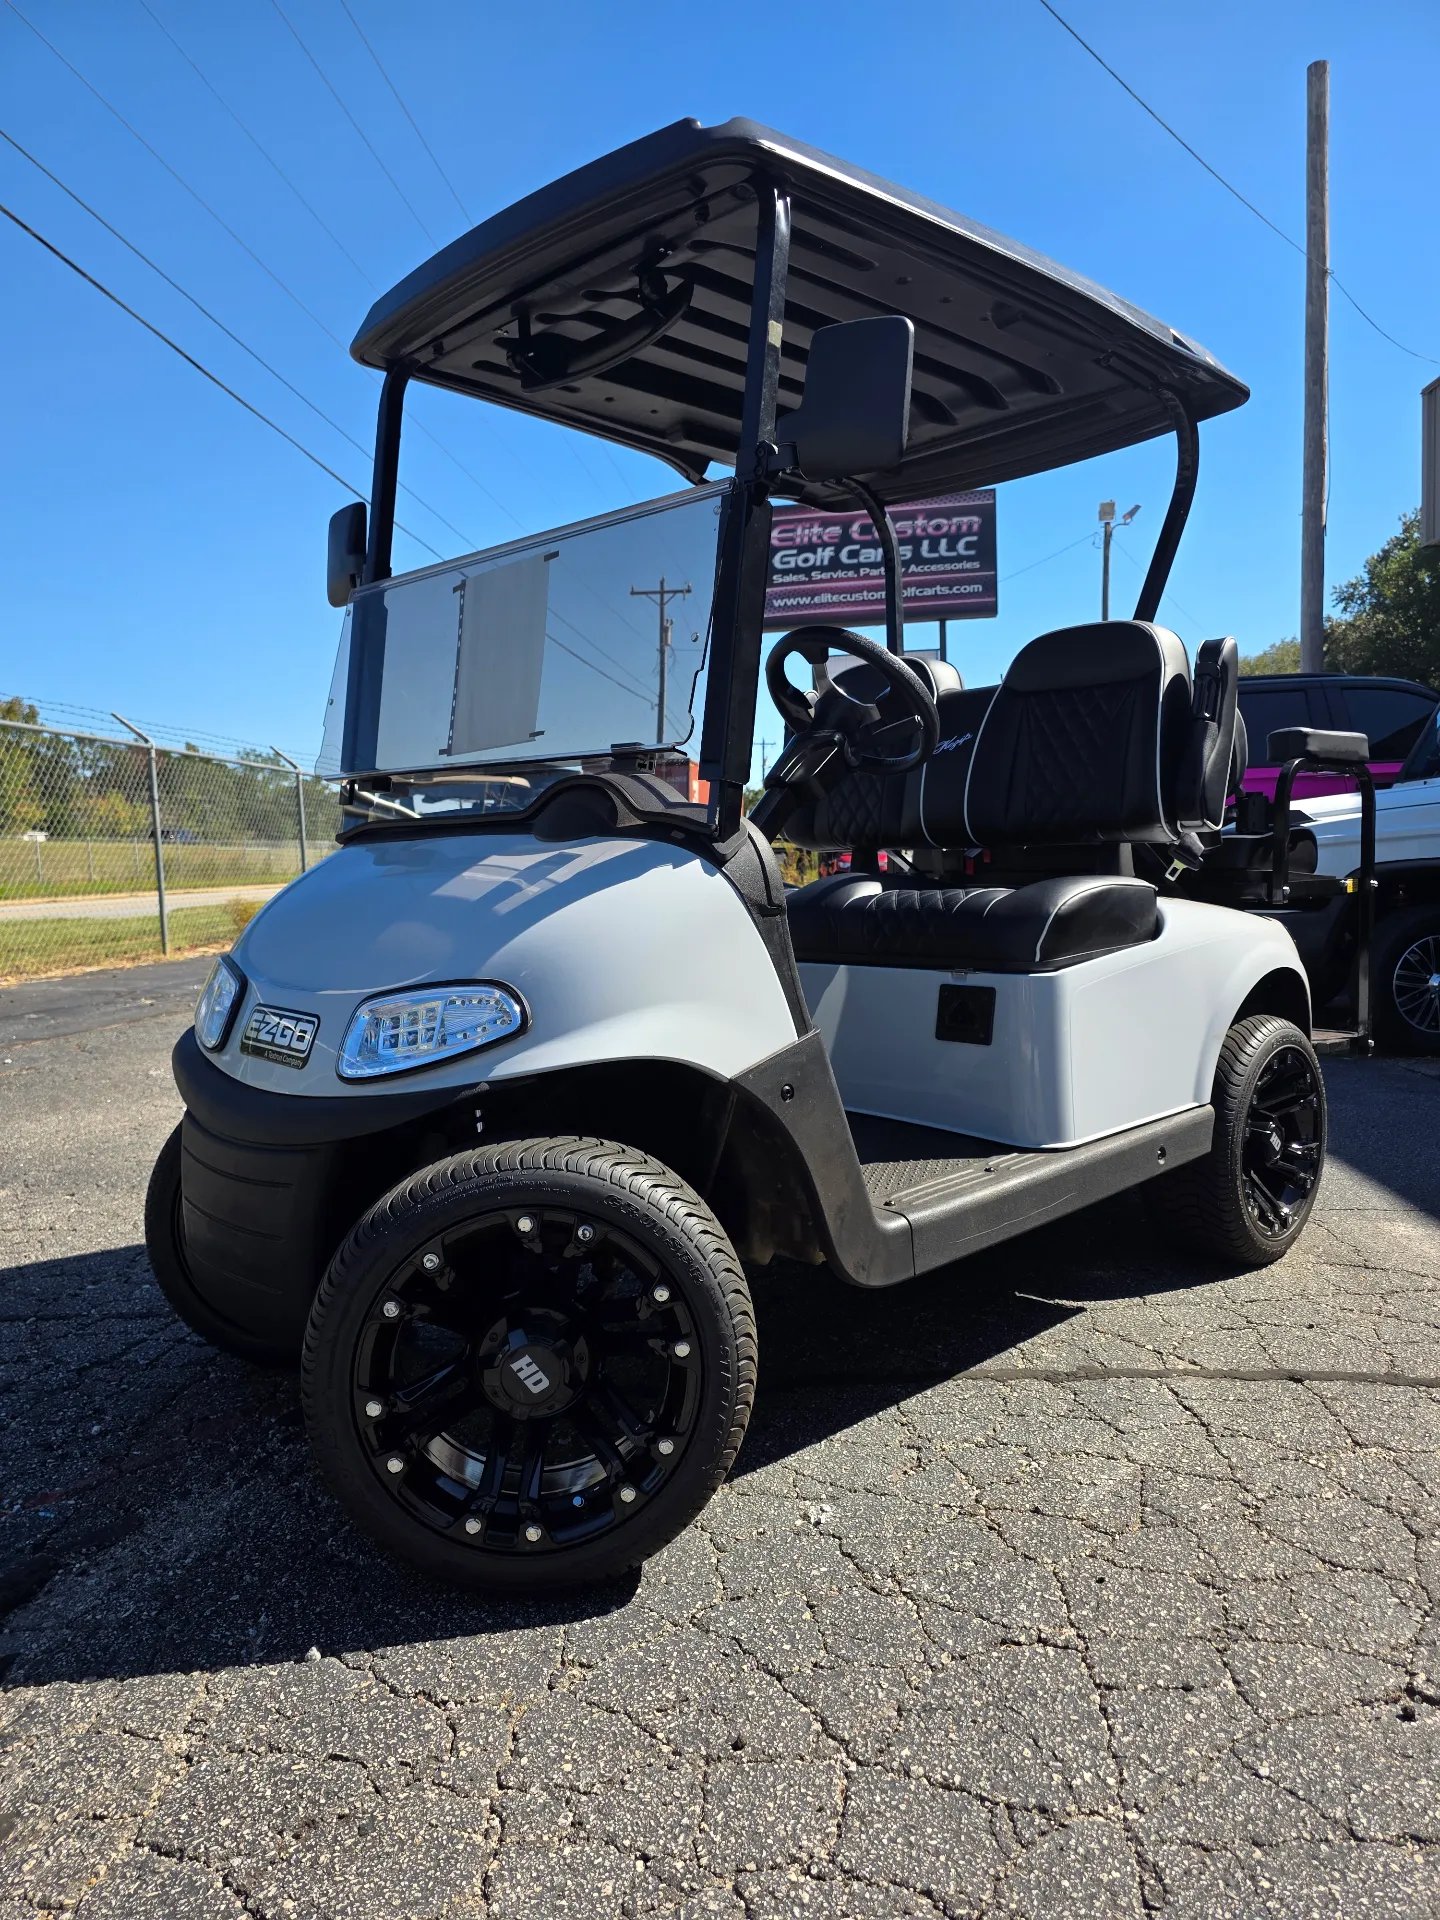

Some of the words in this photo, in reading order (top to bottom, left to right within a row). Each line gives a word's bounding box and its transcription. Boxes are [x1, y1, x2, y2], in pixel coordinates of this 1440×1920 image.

[770, 521, 843, 547] Elite
[849, 513, 982, 541] Cstom
[772, 546, 835, 569] Golf
[839, 544, 913, 565] Cars
[920, 536, 979, 558] LLC
[772, 573, 809, 584] Sales,
[811, 570, 857, 581] Service,
[908, 560, 981, 574] Accessories
[772, 584, 983, 608] www.elitecustomolfcarts.com
[282, 1055, 304, 1069] Company
[510, 1354, 550, 1394] HD
